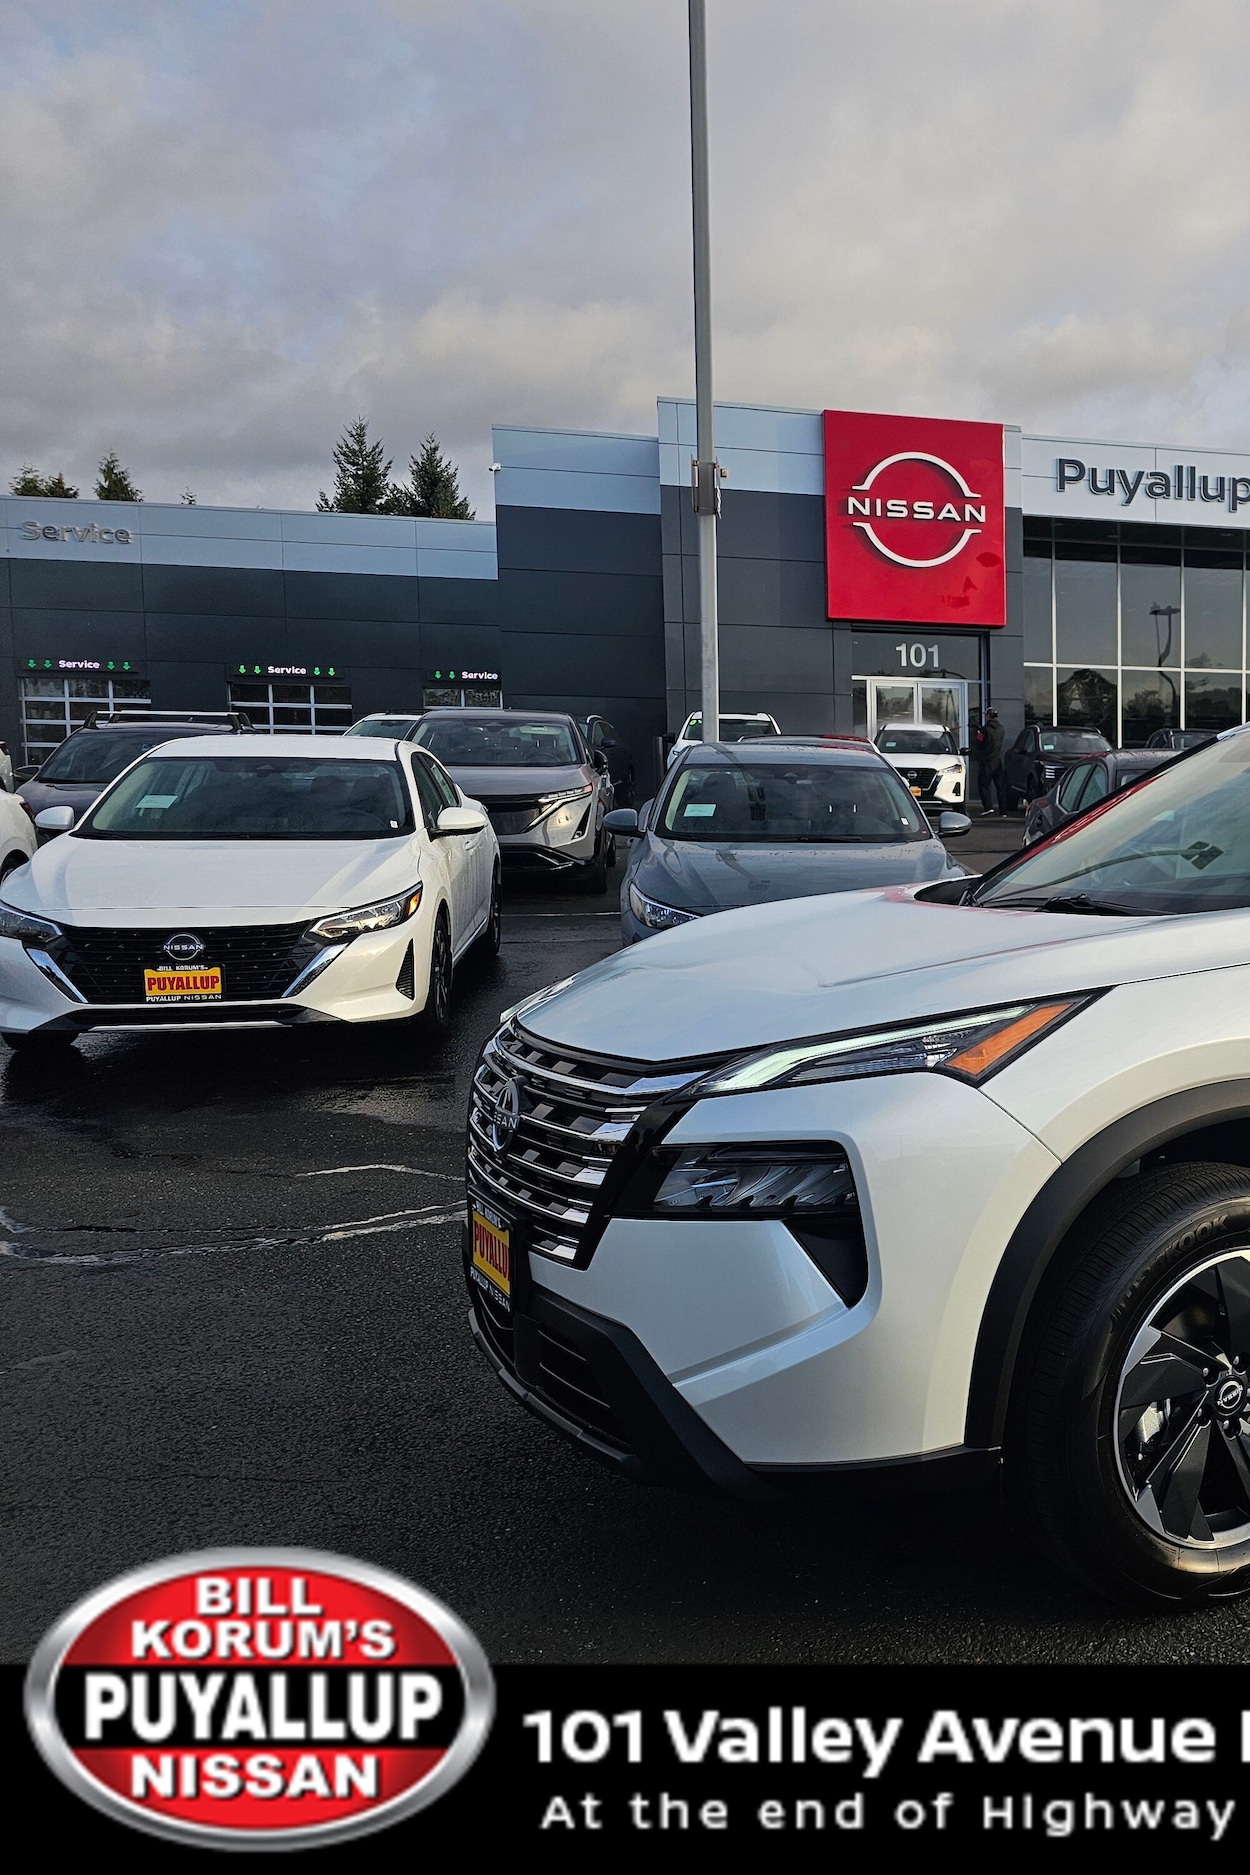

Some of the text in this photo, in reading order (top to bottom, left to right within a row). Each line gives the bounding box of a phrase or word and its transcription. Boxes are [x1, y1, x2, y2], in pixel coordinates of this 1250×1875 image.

[847, 496, 986, 523] NISSAN
[20, 521, 133, 545] Service
[896, 643, 940, 668] 101
[58, 659, 101, 670] Service
[267, 665, 307, 676] Service
[461, 670, 498, 681] Service
[147, 975, 220, 991] PUYALLUP
[146, 993, 222, 1003] PUYALLUP NISSAN
[473, 1218, 510, 1280] PUYALLU
